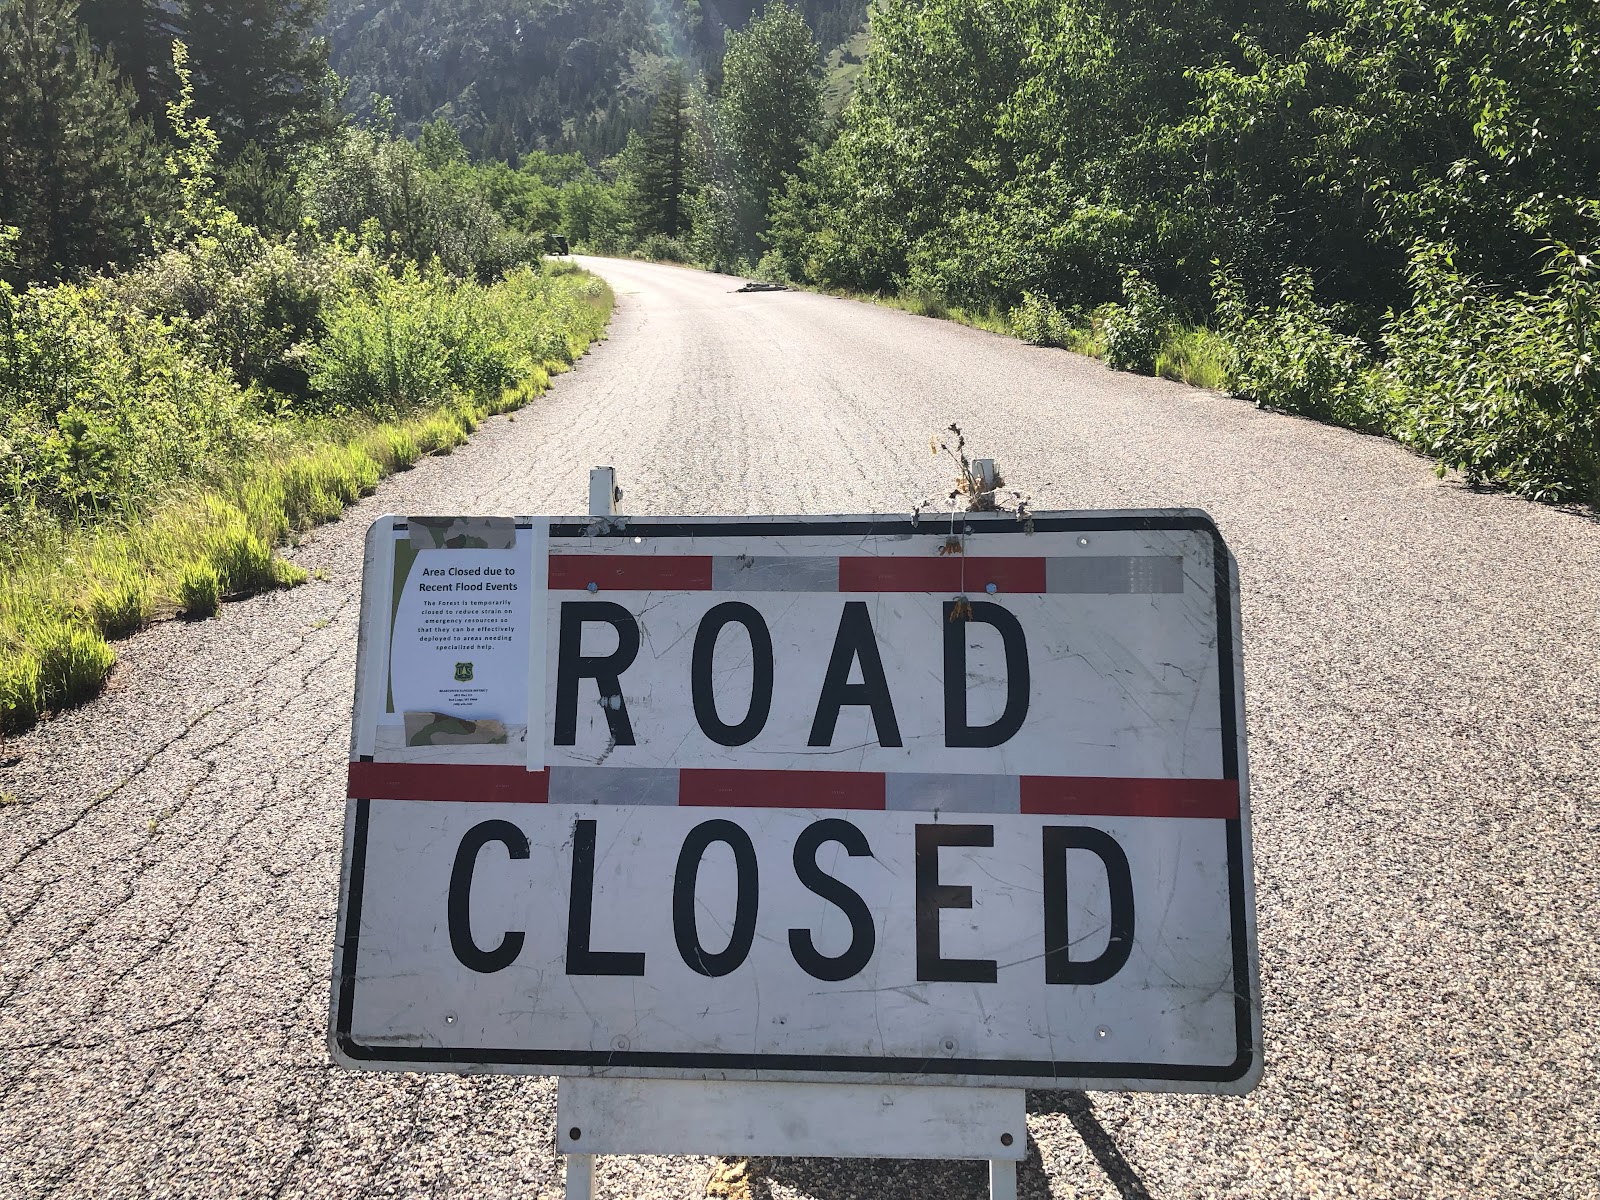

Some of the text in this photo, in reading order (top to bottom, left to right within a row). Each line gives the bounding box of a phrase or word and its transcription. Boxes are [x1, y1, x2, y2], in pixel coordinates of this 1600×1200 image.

[419, 582, 518, 592] Recent Flood Events
[422, 566, 516, 577] Area Closed due to
[554, 601, 1030, 748] ROAD
[448, 819, 1135, 985] CLOSED
